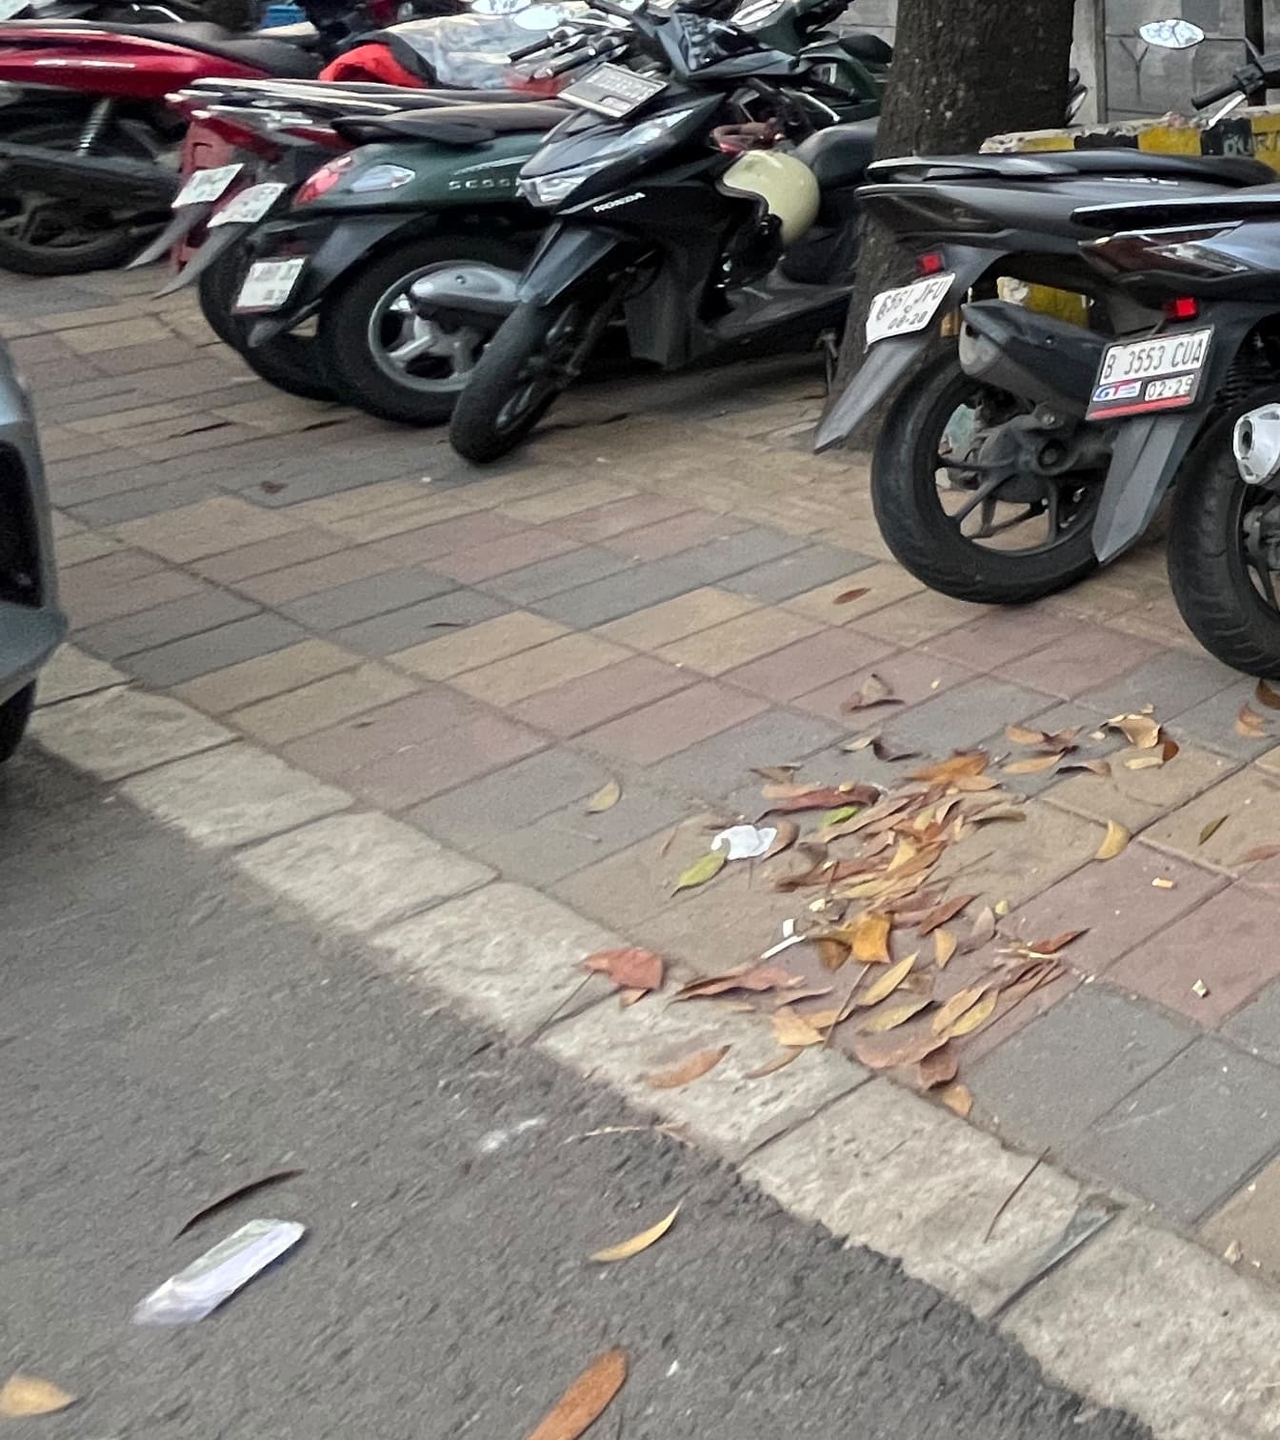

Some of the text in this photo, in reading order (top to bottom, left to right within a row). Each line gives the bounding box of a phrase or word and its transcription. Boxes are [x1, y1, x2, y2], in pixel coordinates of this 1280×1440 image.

[1103, 339, 1203, 380] B 3553 CUA
